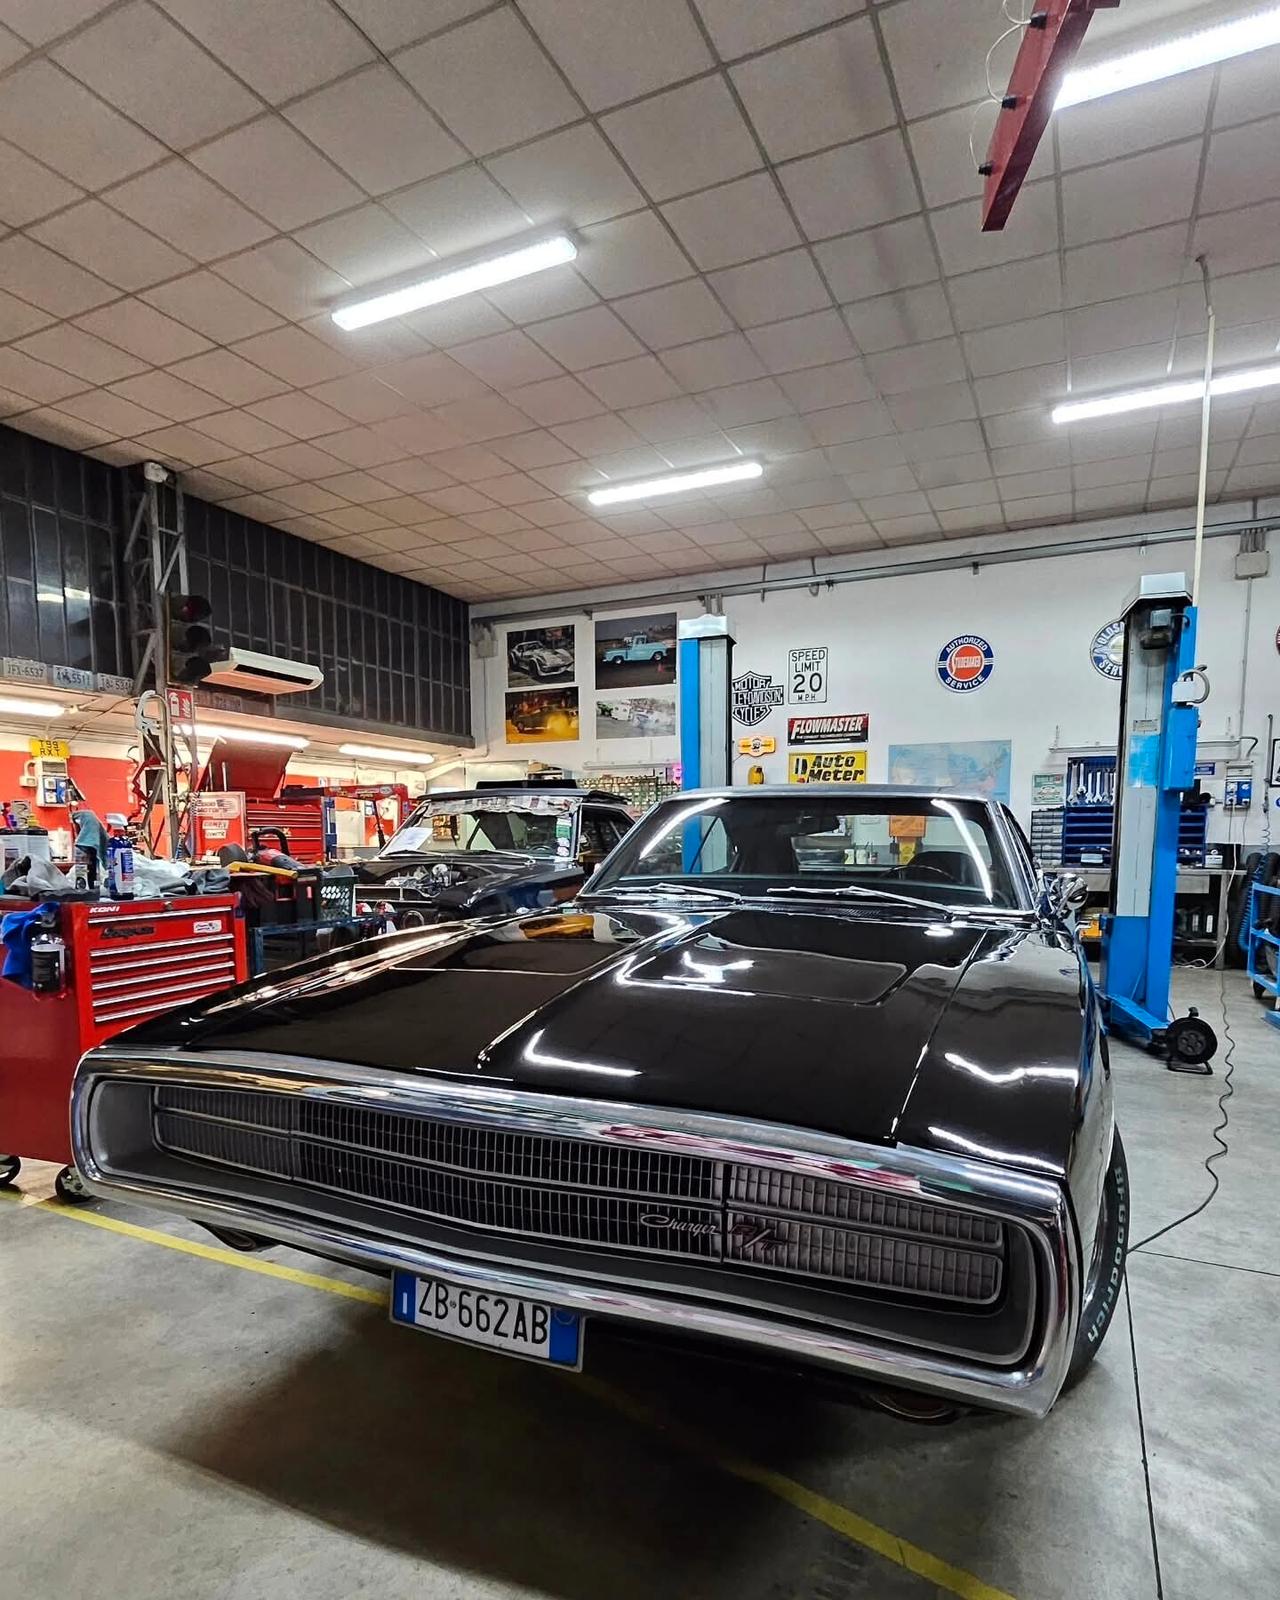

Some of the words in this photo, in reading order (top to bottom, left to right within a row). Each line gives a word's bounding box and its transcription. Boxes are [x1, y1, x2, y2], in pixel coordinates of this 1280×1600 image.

[945, 636, 988, 653] AUTHORIZED
[791, 649, 825, 662] SPEED
[794, 661, 821, 673] LIMIT
[734, 677, 767, 691] MOTOR
[792, 672, 823, 693] 20
[945, 674, 985, 689] SERVICE
[732, 688, 782, 705] LEY-DAVIDSON
[734, 706, 767, 722] CYCLES
[791, 717, 862, 739] FLOWMASTER
[811, 755, 856, 769] Auto
[808, 767, 865, 783] Meter
[89, 905, 121, 914] KONI
[640, 1212, 722, 1237] Charger
